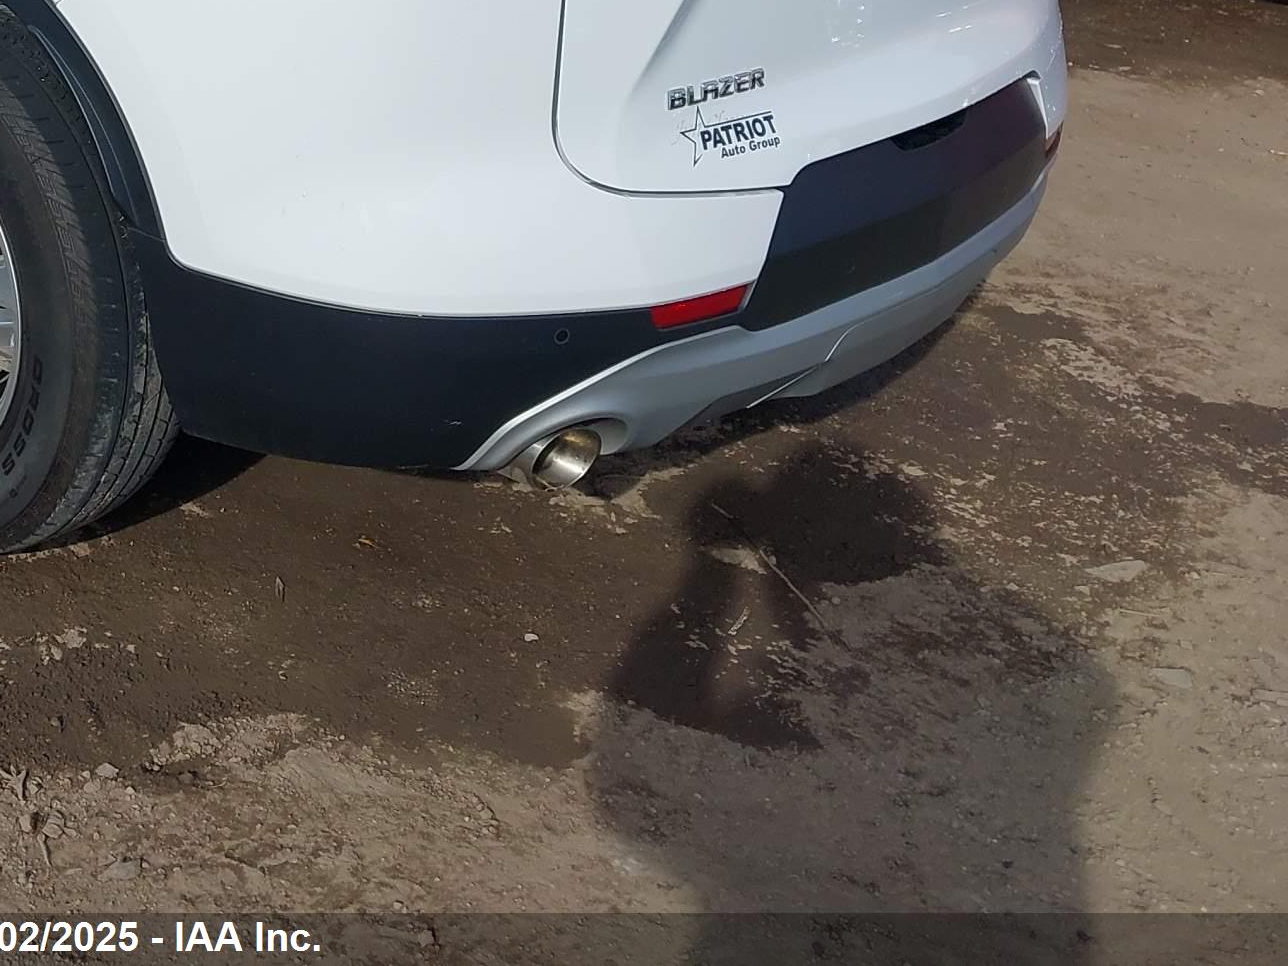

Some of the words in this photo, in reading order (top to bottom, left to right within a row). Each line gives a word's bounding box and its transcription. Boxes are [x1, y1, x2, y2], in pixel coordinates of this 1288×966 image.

[667, 67, 765, 111] BLAZER
[700, 114, 777, 151] PATRIOT
[720, 144, 747, 159] Auto
[748, 136, 781, 151] Group
